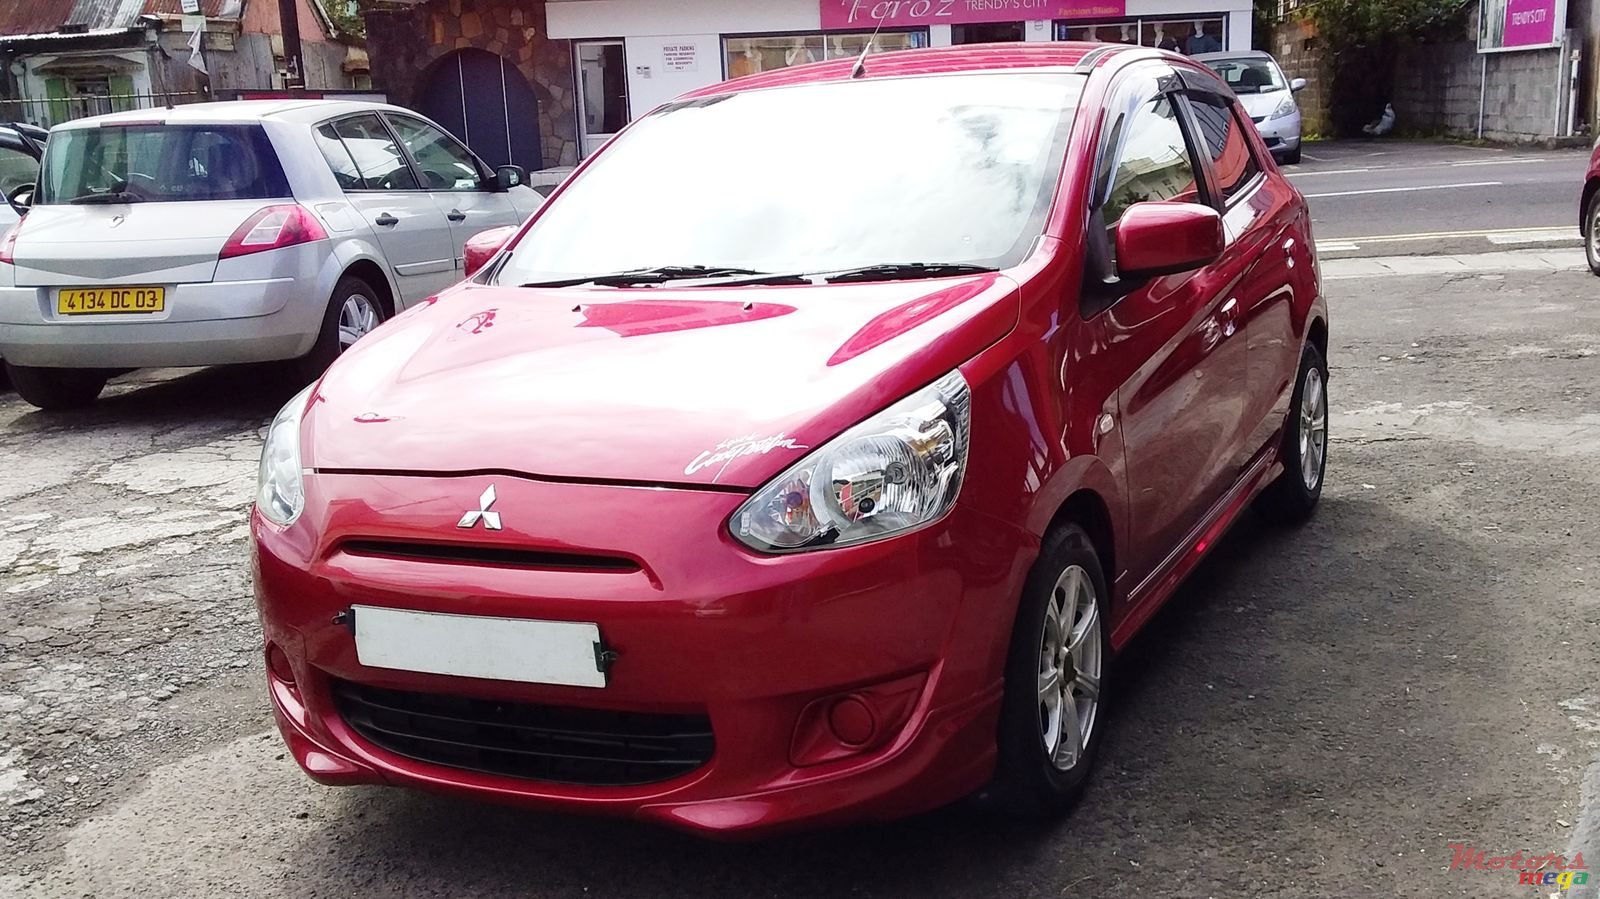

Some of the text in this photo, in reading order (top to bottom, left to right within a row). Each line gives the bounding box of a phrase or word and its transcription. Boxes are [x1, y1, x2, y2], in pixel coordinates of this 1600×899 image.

[965, 0, 1048, 11] TRENDY'S CITY
[1058, 8, 1091, 16] Fashion
[1534, 8, 1547, 23] CITY
[67, 290, 156, 310] 4134 DC 03
